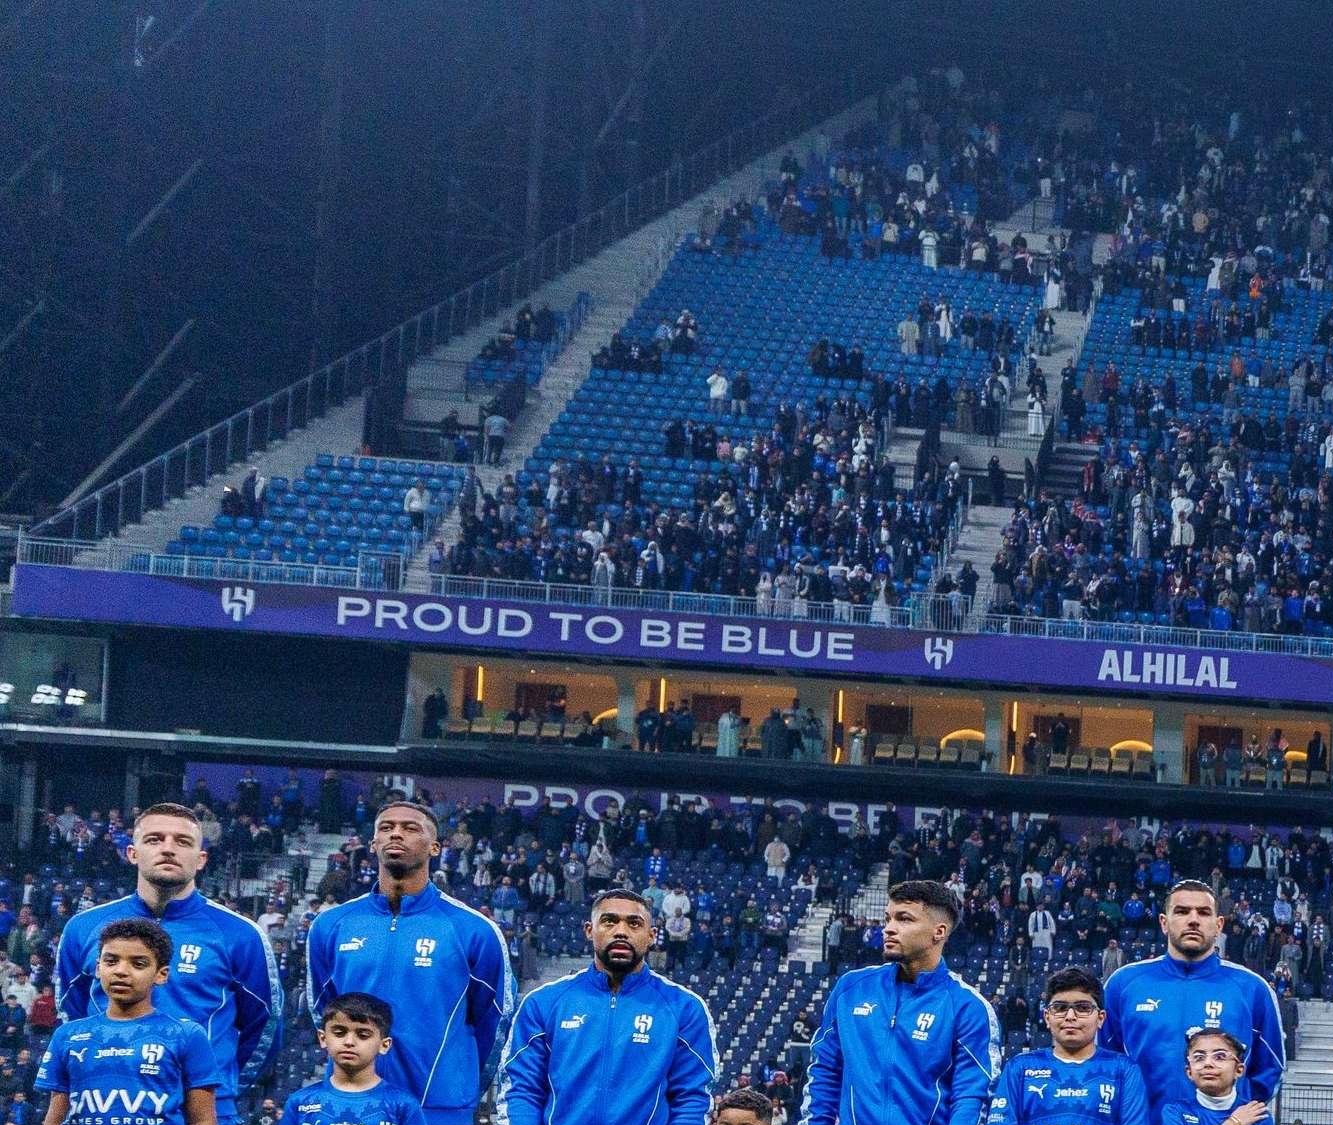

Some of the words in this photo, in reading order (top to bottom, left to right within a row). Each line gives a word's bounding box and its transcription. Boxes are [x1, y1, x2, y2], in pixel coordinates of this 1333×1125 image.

[335, 596, 533, 638] PROUD
[549, 611, 624, 645] TO
[639, 619, 706, 652] BE
[721, 624, 855, 661] BLUE
[1097, 648, 1238, 689] ALHILAL
[110, 1116, 164, 1125] GROUP
